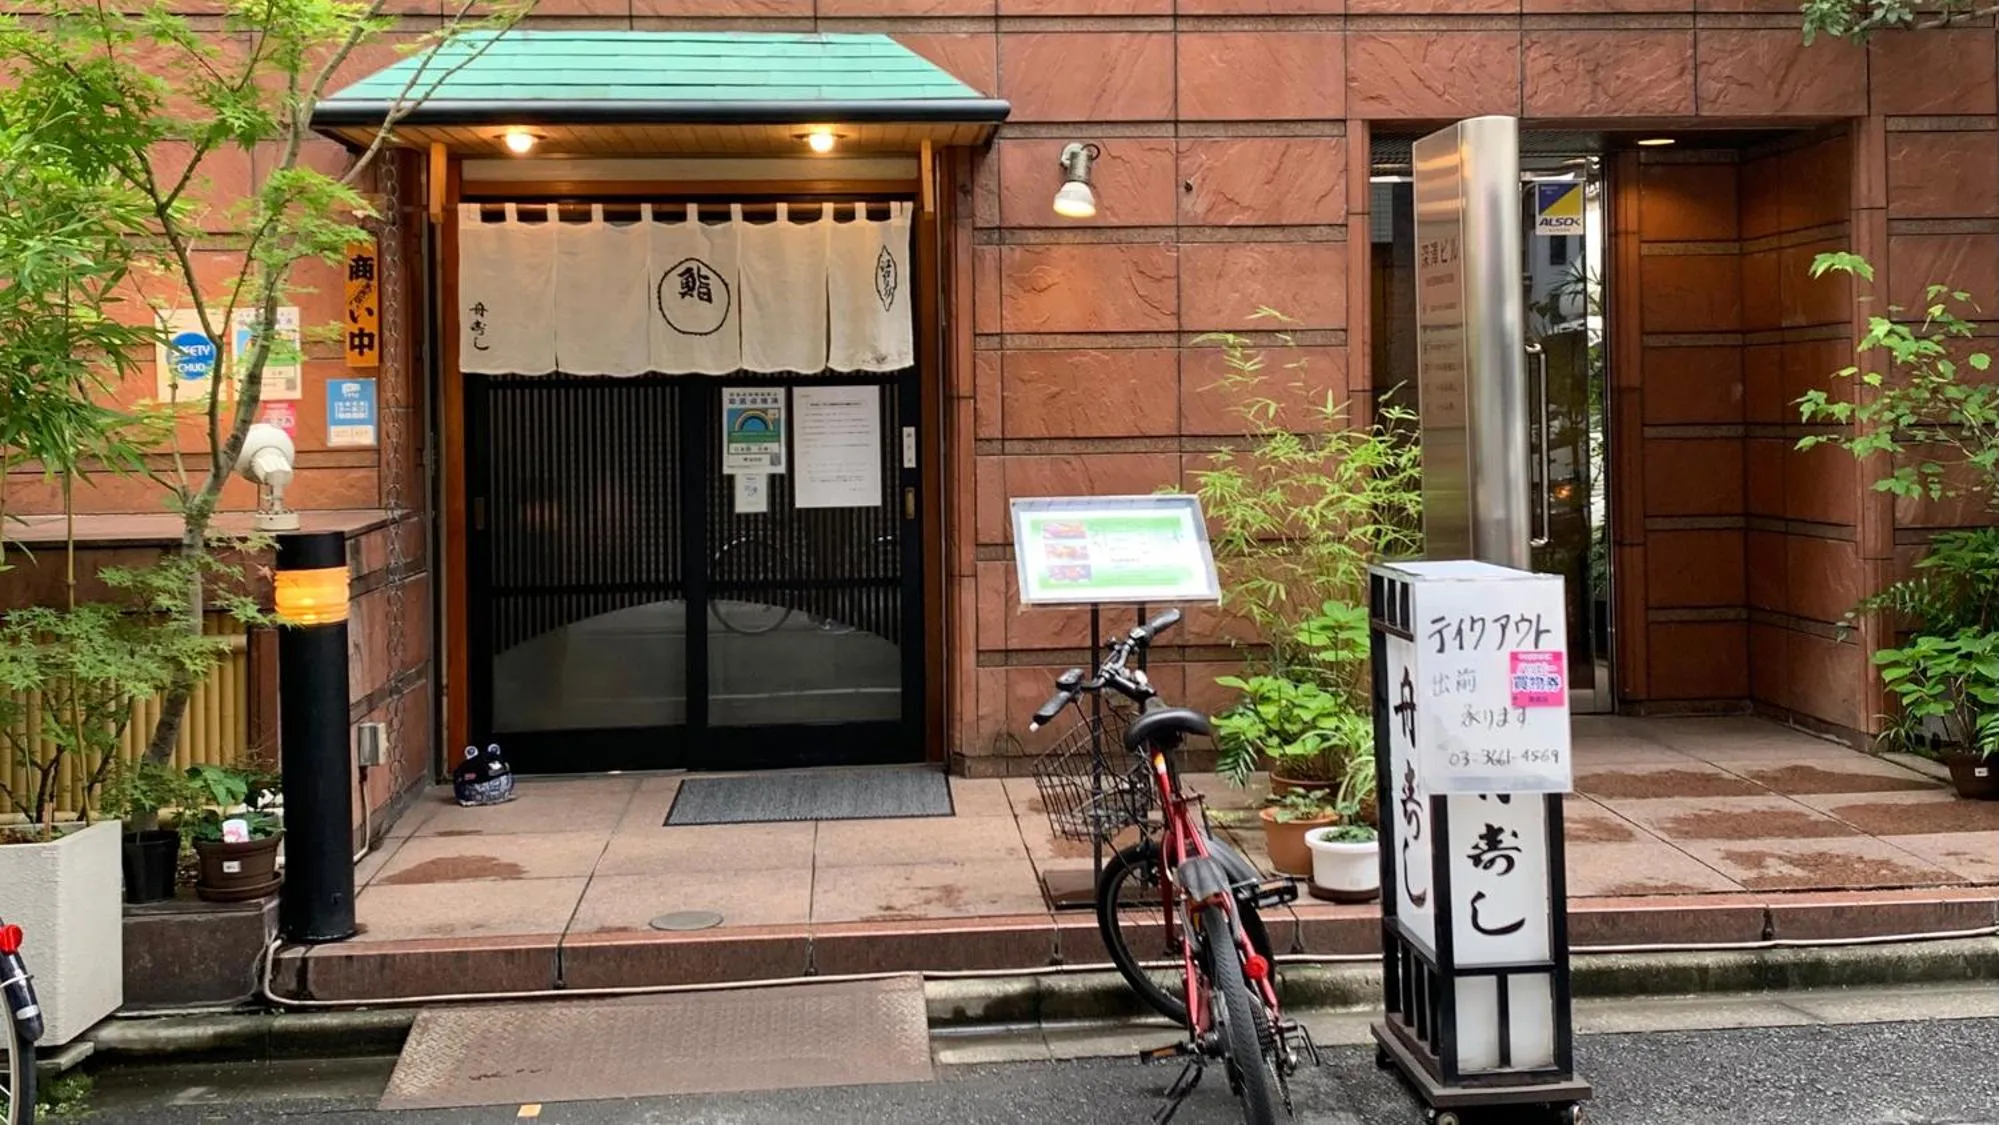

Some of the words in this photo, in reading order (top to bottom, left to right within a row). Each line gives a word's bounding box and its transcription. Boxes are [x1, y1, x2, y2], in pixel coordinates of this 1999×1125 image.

[1539, 217, 1580, 227] ALSOK
[677, 264, 713, 304] 鮨
[348, 253, 375, 357] 商い中
[1432, 667, 1477, 698] 出前
[1448, 748, 1560, 768] 03-3661-4569
[1466, 793, 1526, 936] 寿し
